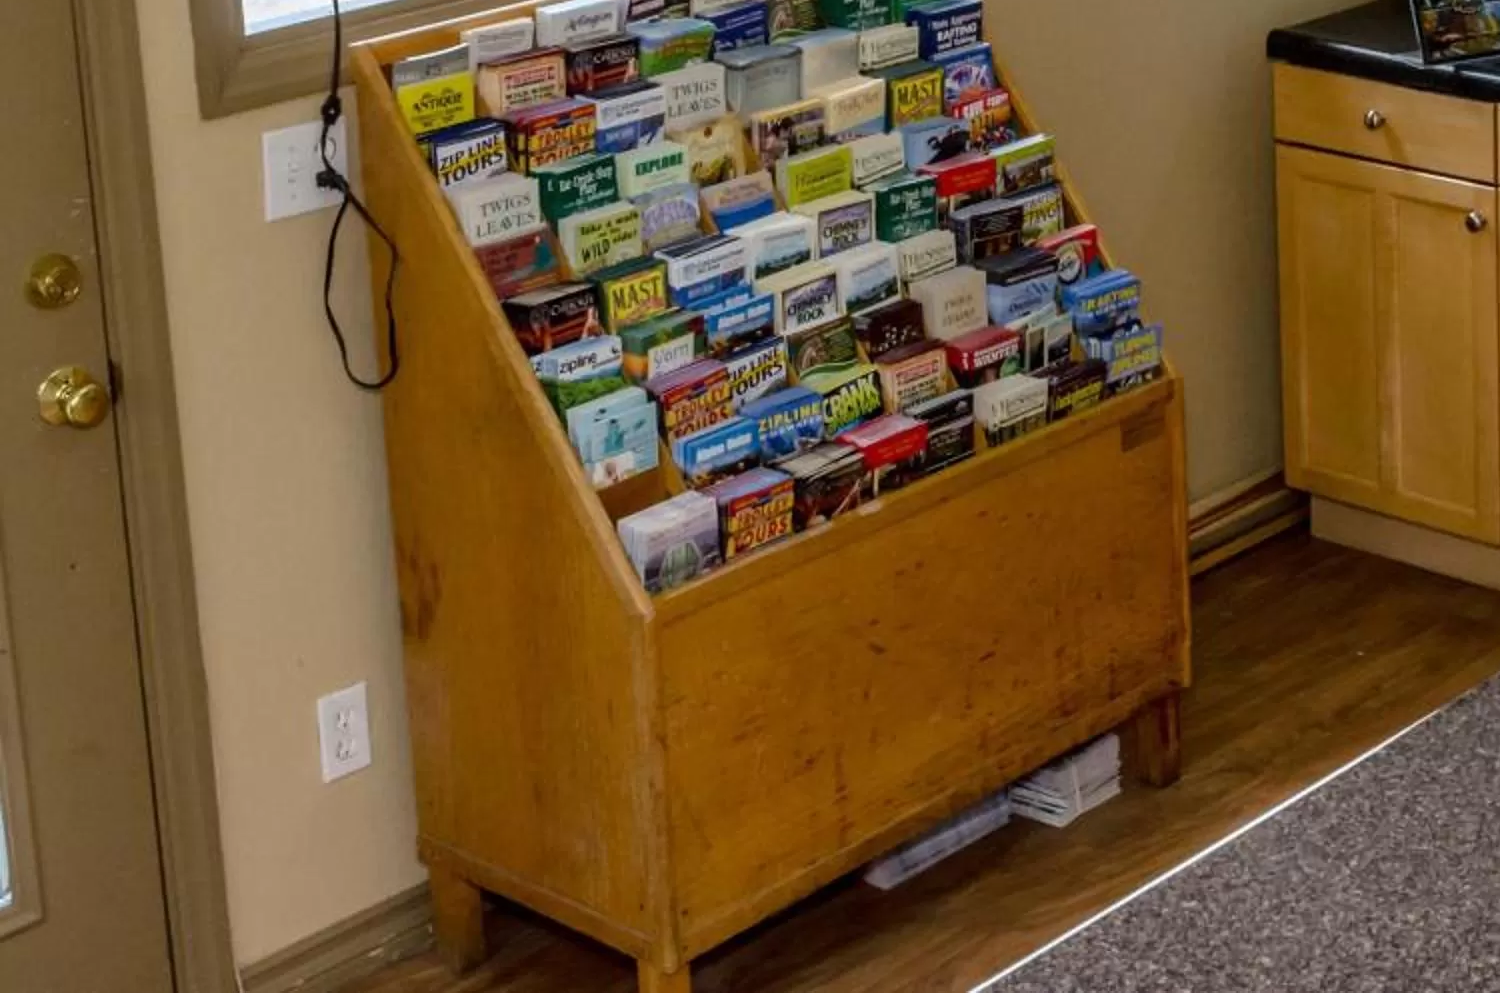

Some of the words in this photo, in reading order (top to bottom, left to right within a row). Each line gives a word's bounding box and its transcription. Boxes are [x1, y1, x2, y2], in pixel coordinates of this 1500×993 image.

[671, 78, 719, 101] TWIGS
[667, 96, 722, 118] LEAVES
[439, 148, 465, 172] ZIP
[467, 134, 502, 158] LINE
[634, 150, 684, 177] EXPLORE
[441, 152, 504, 187] TOURS
[479, 191, 532, 218] TWIGS
[475, 211, 537, 239] LEAVES
[580, 221, 603, 237] Take
[615, 210, 640, 227] walk
[581, 240, 611, 263] WILD
[611, 274, 662, 310] MAST
[786, 291, 833, 317] CHIMNEY
[797, 306, 825, 324] ROCK
[558, 351, 598, 376] zipline
[750, 343, 781, 368] LINE
[729, 361, 783, 400] TOURS
[758, 402, 822, 433] ZIPLINE
[735, 515, 789, 554] TOURS
